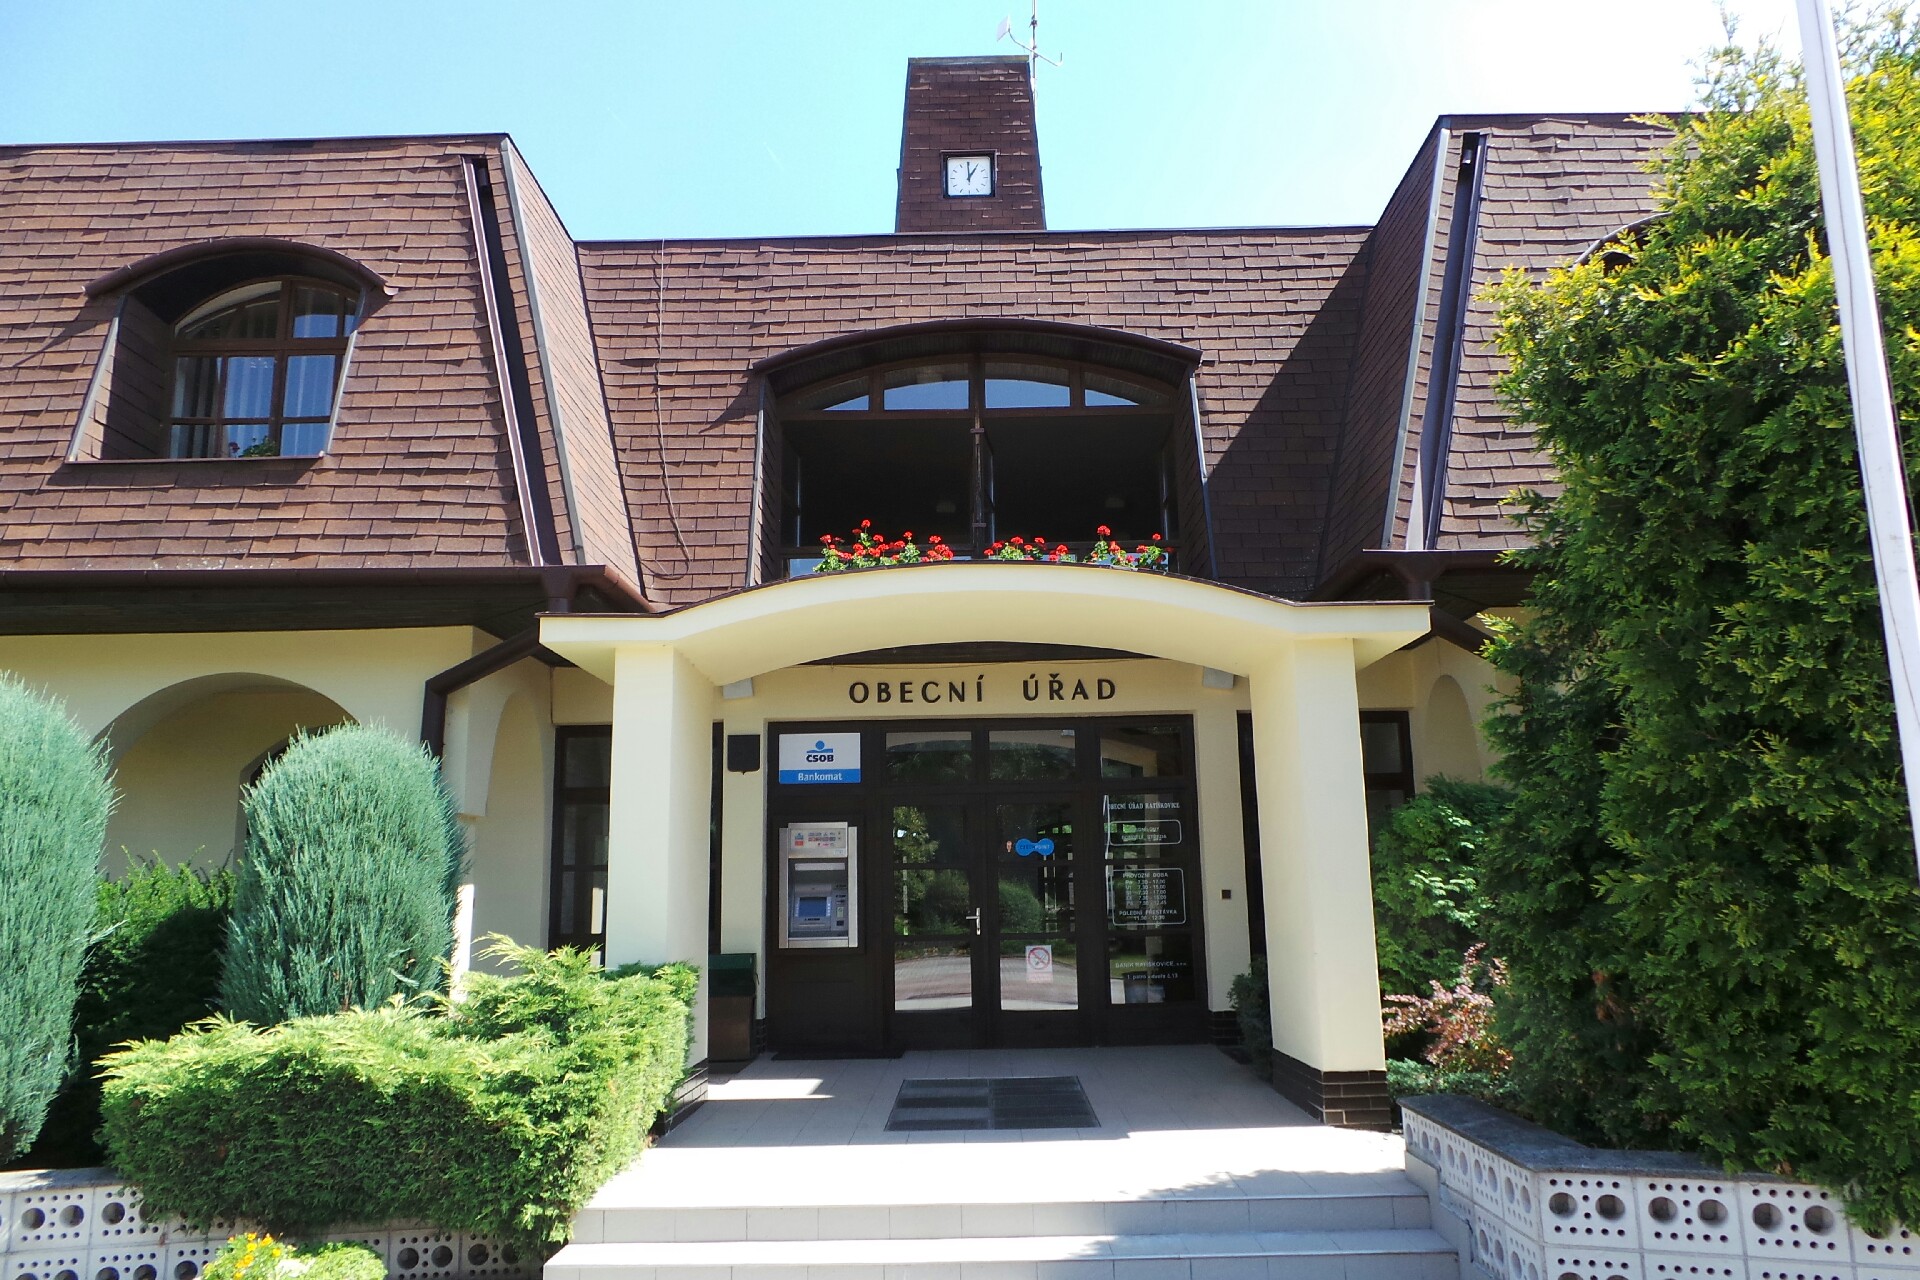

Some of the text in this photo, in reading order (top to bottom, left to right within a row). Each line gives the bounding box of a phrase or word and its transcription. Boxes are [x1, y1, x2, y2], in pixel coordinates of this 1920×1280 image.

[848, 673, 1116, 703] OBECNÍ ÚŘAD
[806, 754, 834, 762] ČSOB
[798, 772, 843, 781] Bankomat
